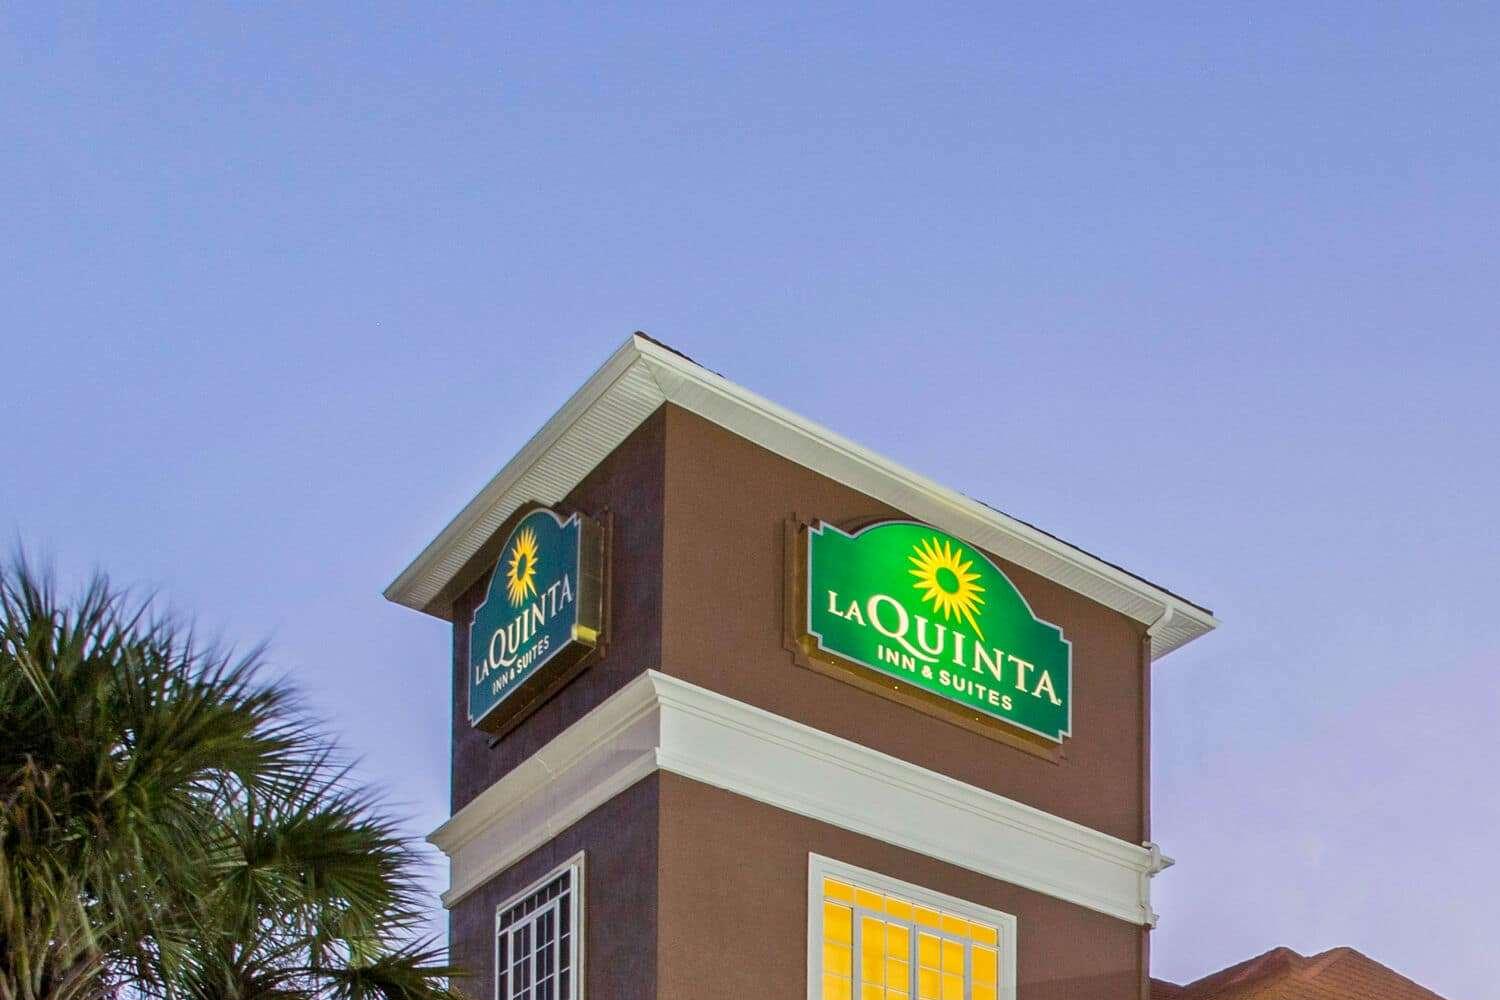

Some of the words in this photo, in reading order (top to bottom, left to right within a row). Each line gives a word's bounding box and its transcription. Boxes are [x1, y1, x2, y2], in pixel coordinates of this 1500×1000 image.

[475, 660, 489, 686] LA
[489, 574, 573, 669] QUINTA
[492, 676, 509, 695] INN
[509, 668, 515, 680] &
[516, 635, 550, 674] SUITES
[827, 590, 866, 627] LA
[866, 595, 1062, 706] QUINTA
[877, 645, 915, 672] INN
[921, 665, 932, 679] &
[939, 670, 1012, 711] SUITES
